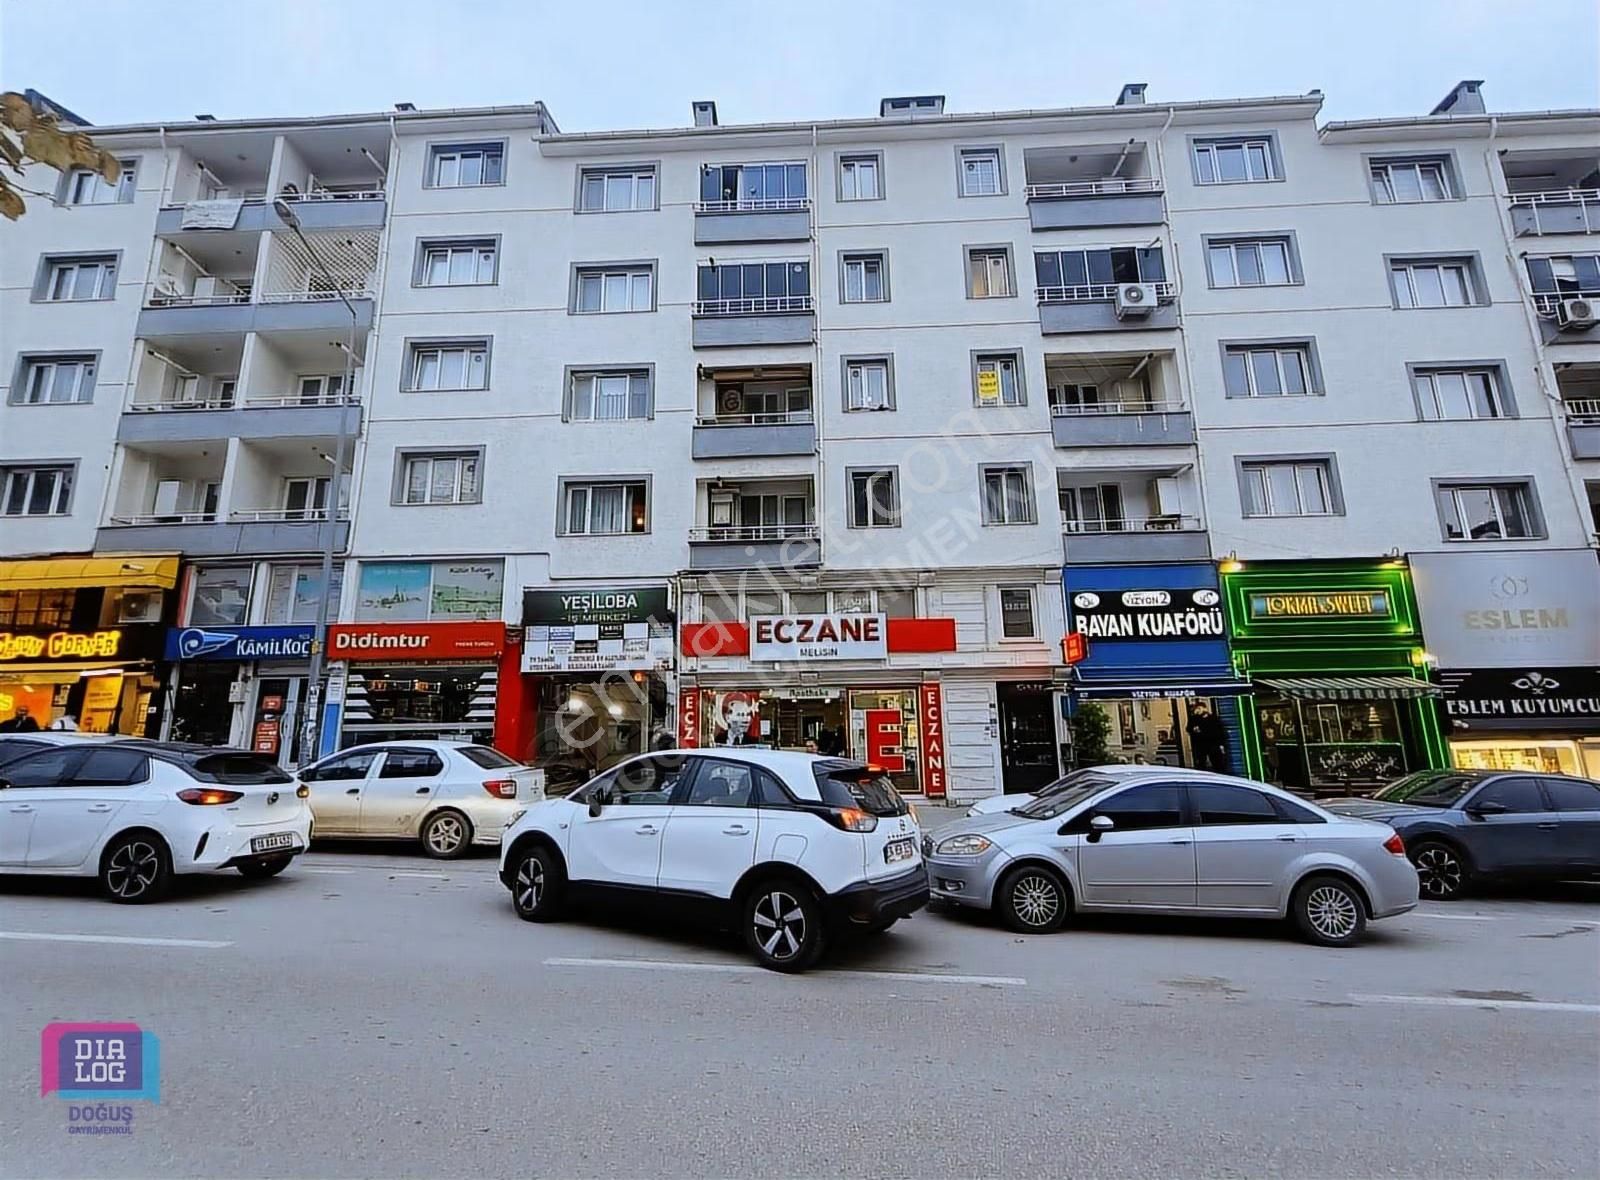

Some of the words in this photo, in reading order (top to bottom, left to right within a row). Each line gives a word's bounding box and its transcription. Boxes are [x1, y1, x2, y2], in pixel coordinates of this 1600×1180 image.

[561, 592, 637, 612] YEŞİLOBA
[1159, 592, 1168, 604] 2
[755, 617, 880, 644] ECZANE
[1076, 613, 1134, 637] BAYAN
[1138, 608, 1223, 636] KUAFÖRÜ
[1463, 608, 1568, 630] ESLEM
[48, 632, 118, 659] CORNER
[336, 632, 430, 649] Didimtur
[683, 696, 695, 741] ECZ
[1446, 699, 1506, 715] ESLEM
[927, 691, 942, 787] ECZANE
